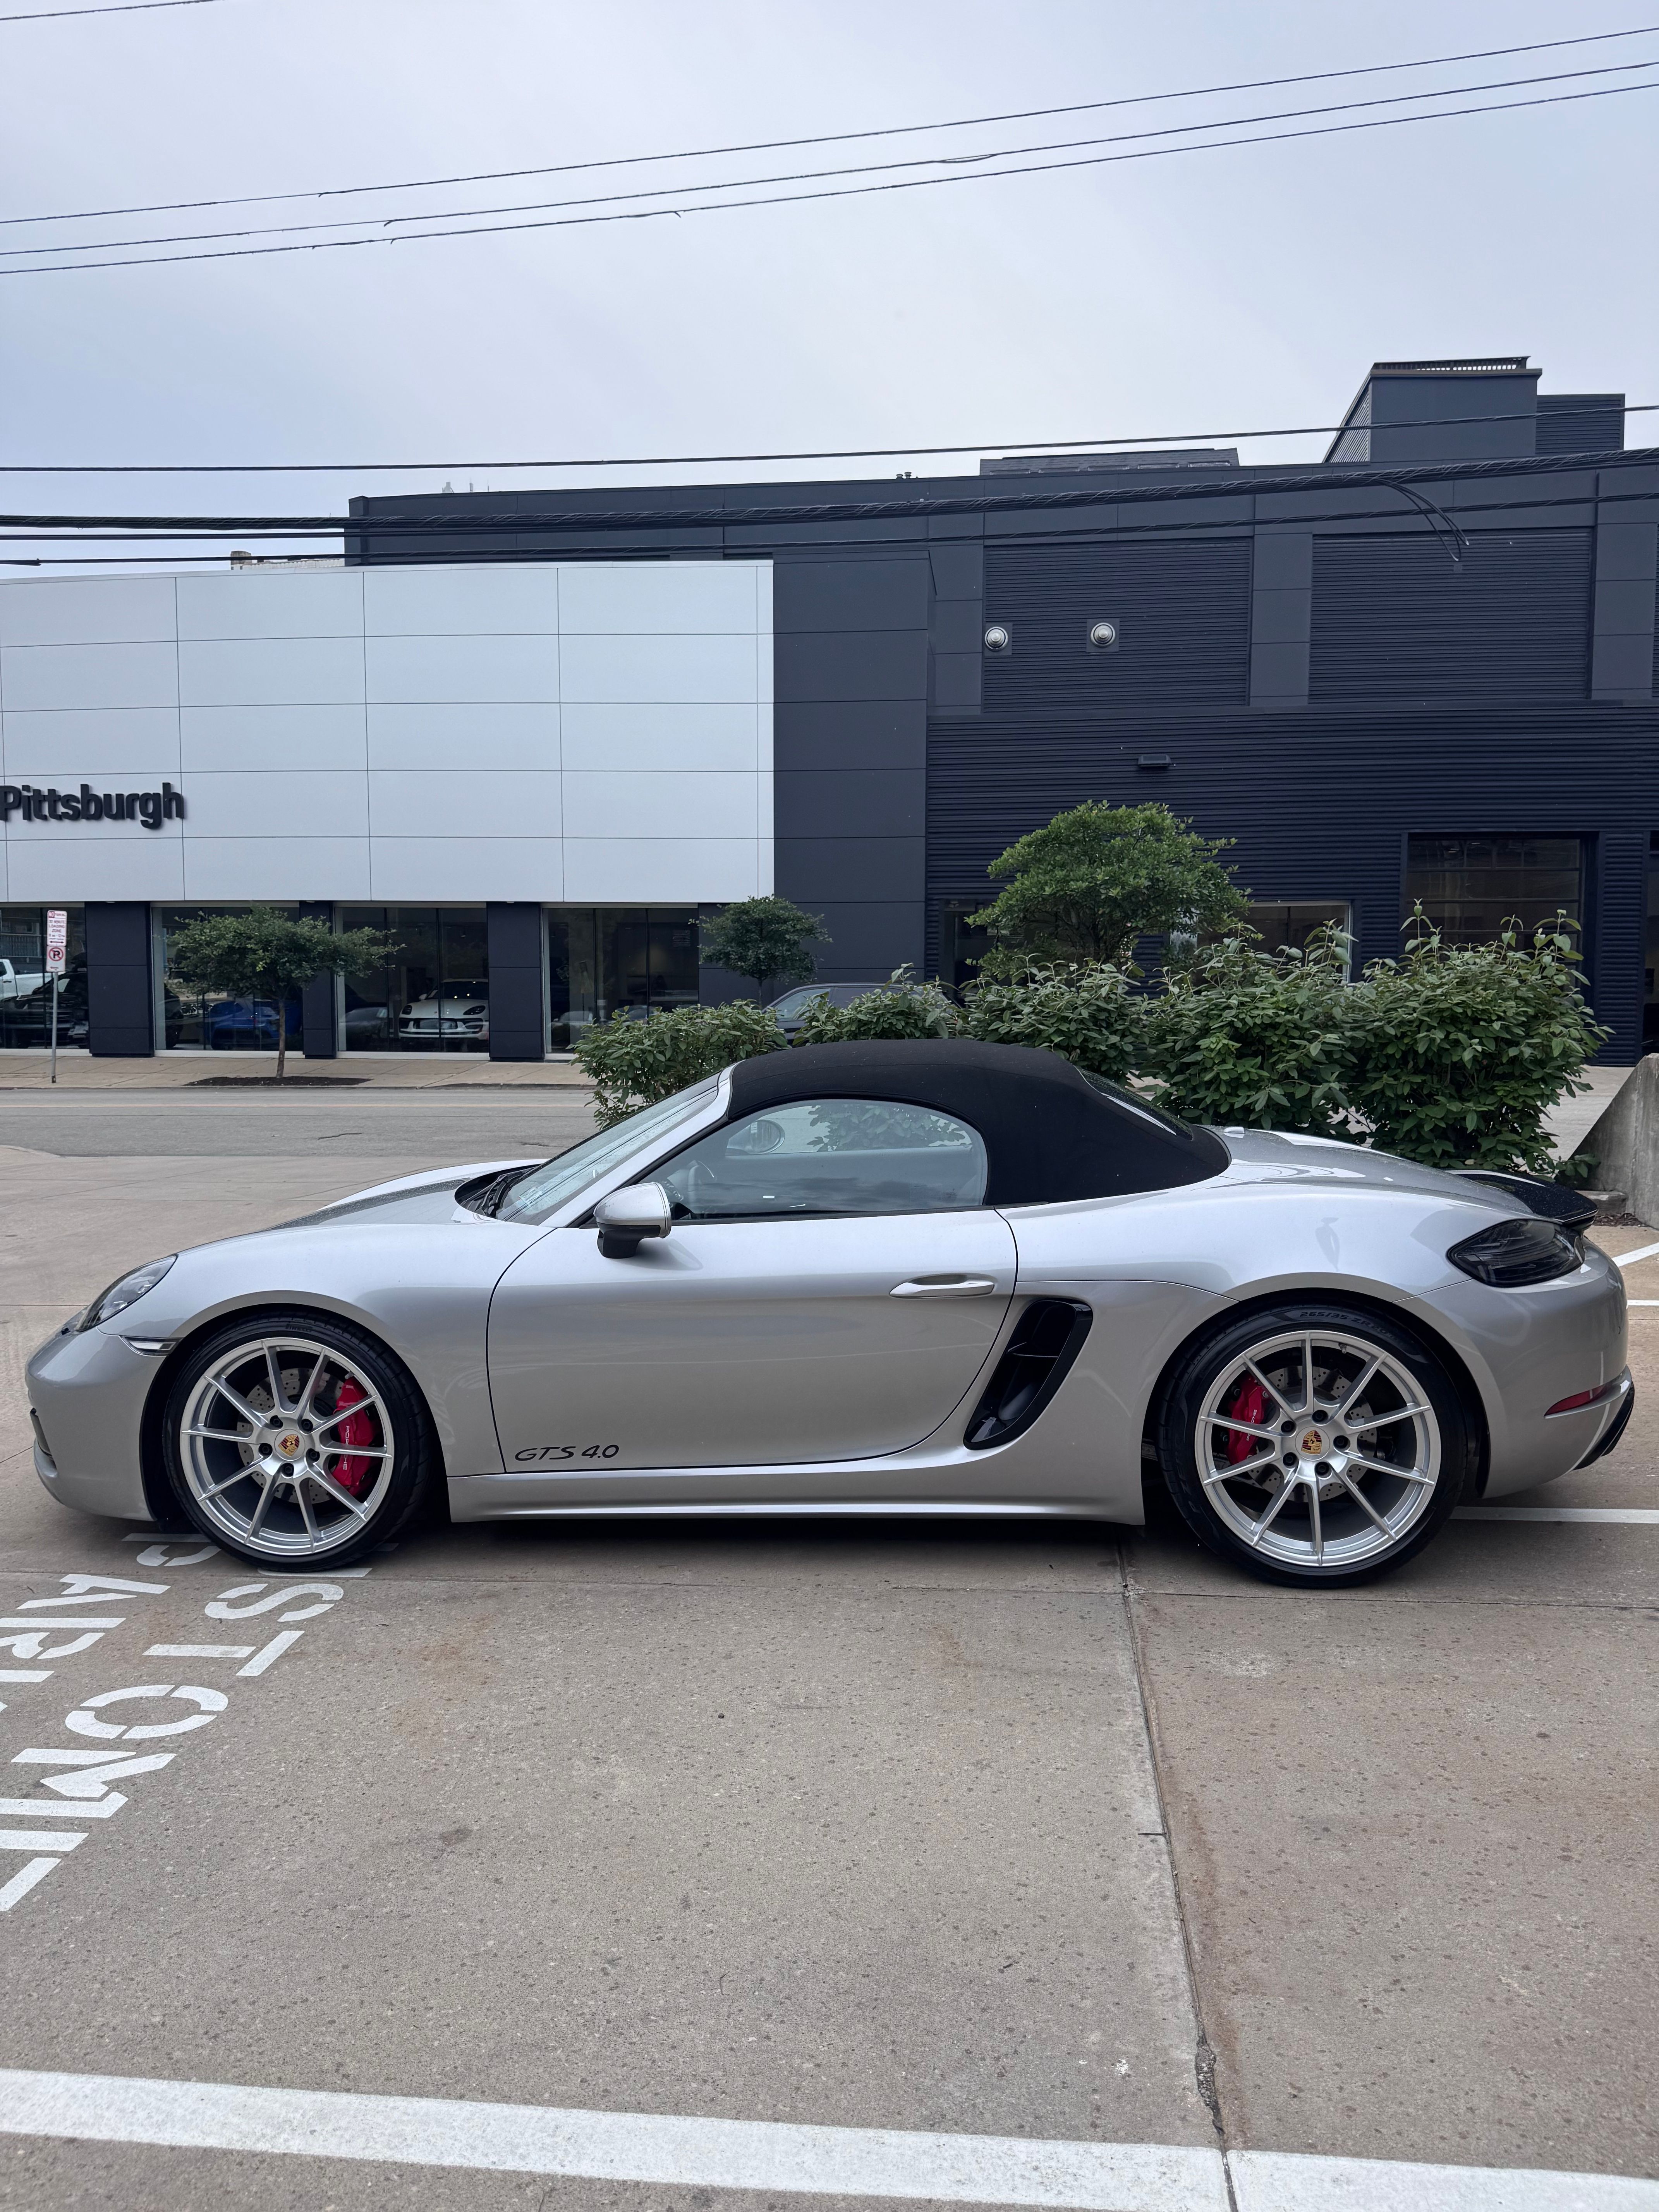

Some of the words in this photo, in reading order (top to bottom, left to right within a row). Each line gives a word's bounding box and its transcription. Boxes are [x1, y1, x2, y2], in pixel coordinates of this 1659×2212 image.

[0, 782, 184, 829] Pittsburgh
[1300, 1311, 1349, 1320] 265/35
[515, 1446, 577, 1461] GTS
[581, 1444, 619, 1458] 4.0
